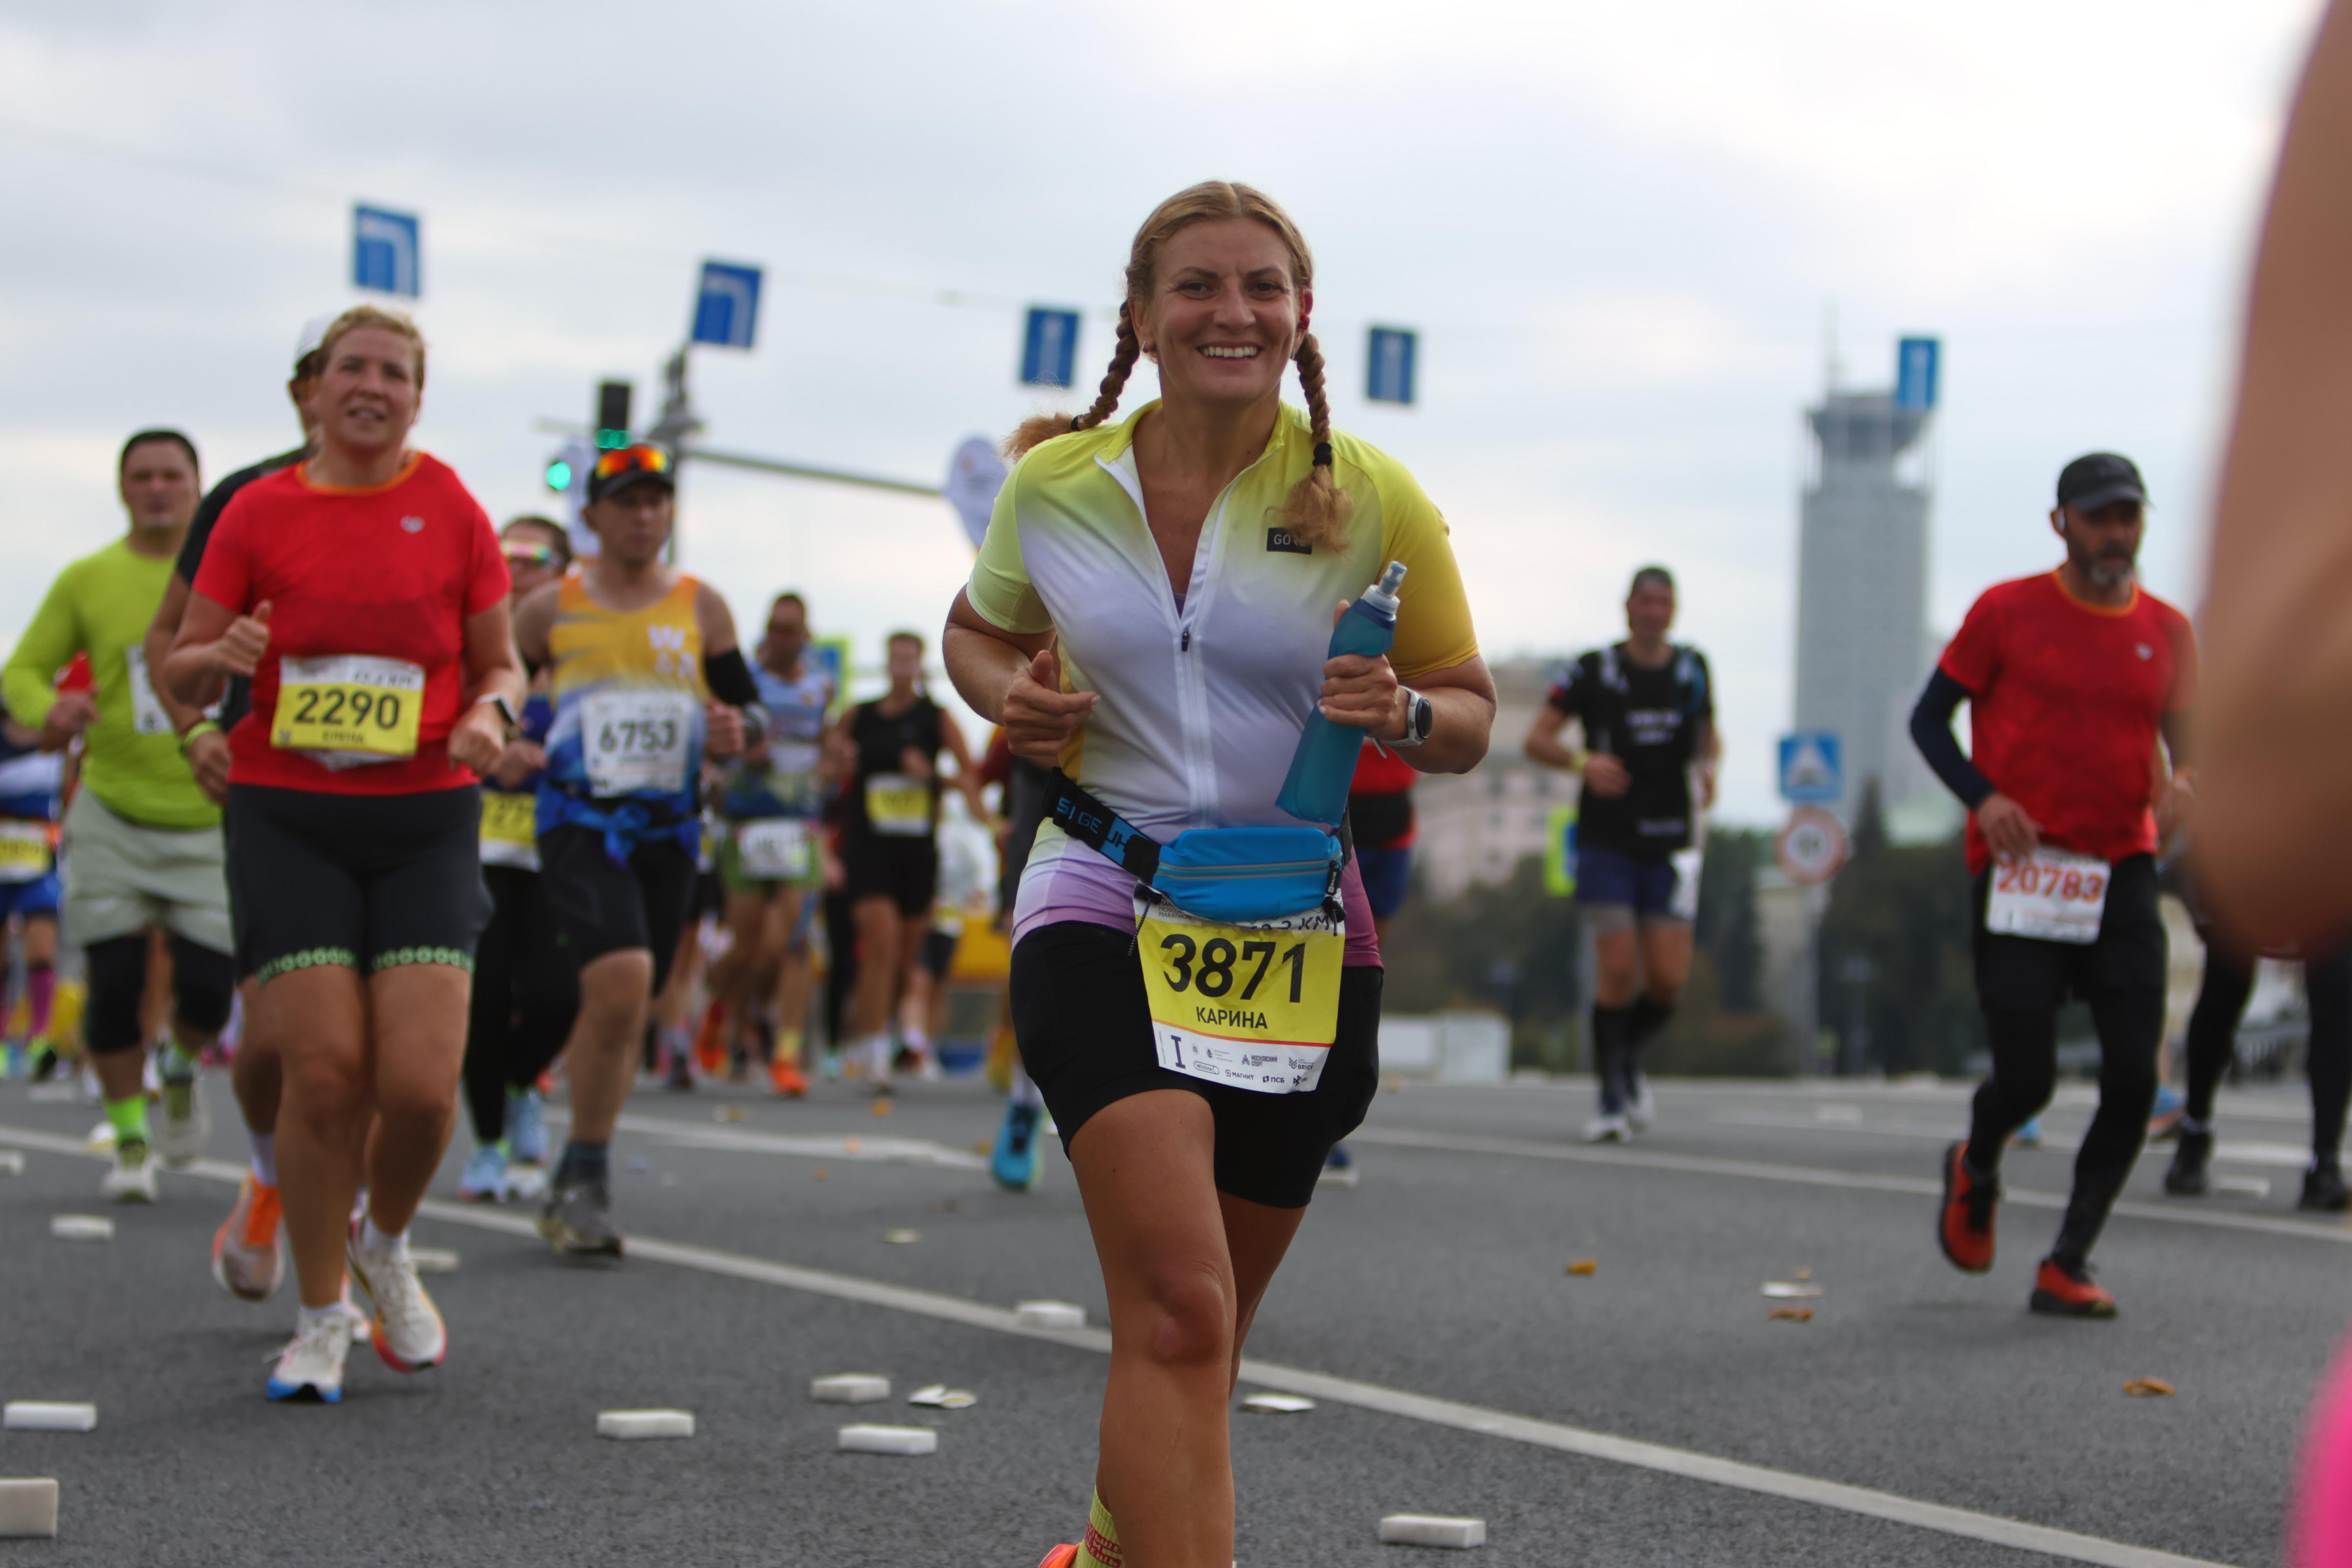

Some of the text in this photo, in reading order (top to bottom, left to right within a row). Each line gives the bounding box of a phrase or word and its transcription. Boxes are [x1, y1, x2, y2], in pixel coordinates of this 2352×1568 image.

[294, 687, 400, 730] 2290
[599, 720, 677, 753] 6753
[1997, 860, 2104, 905] 20783
[1159, 933, 1305, 1004] 3871
[1196, 1006, 1268, 1029] КАРИНА
[1196, 1063, 1213, 1072] Winline
[1232, 1072, 1254, 1080] МАГНИТ
